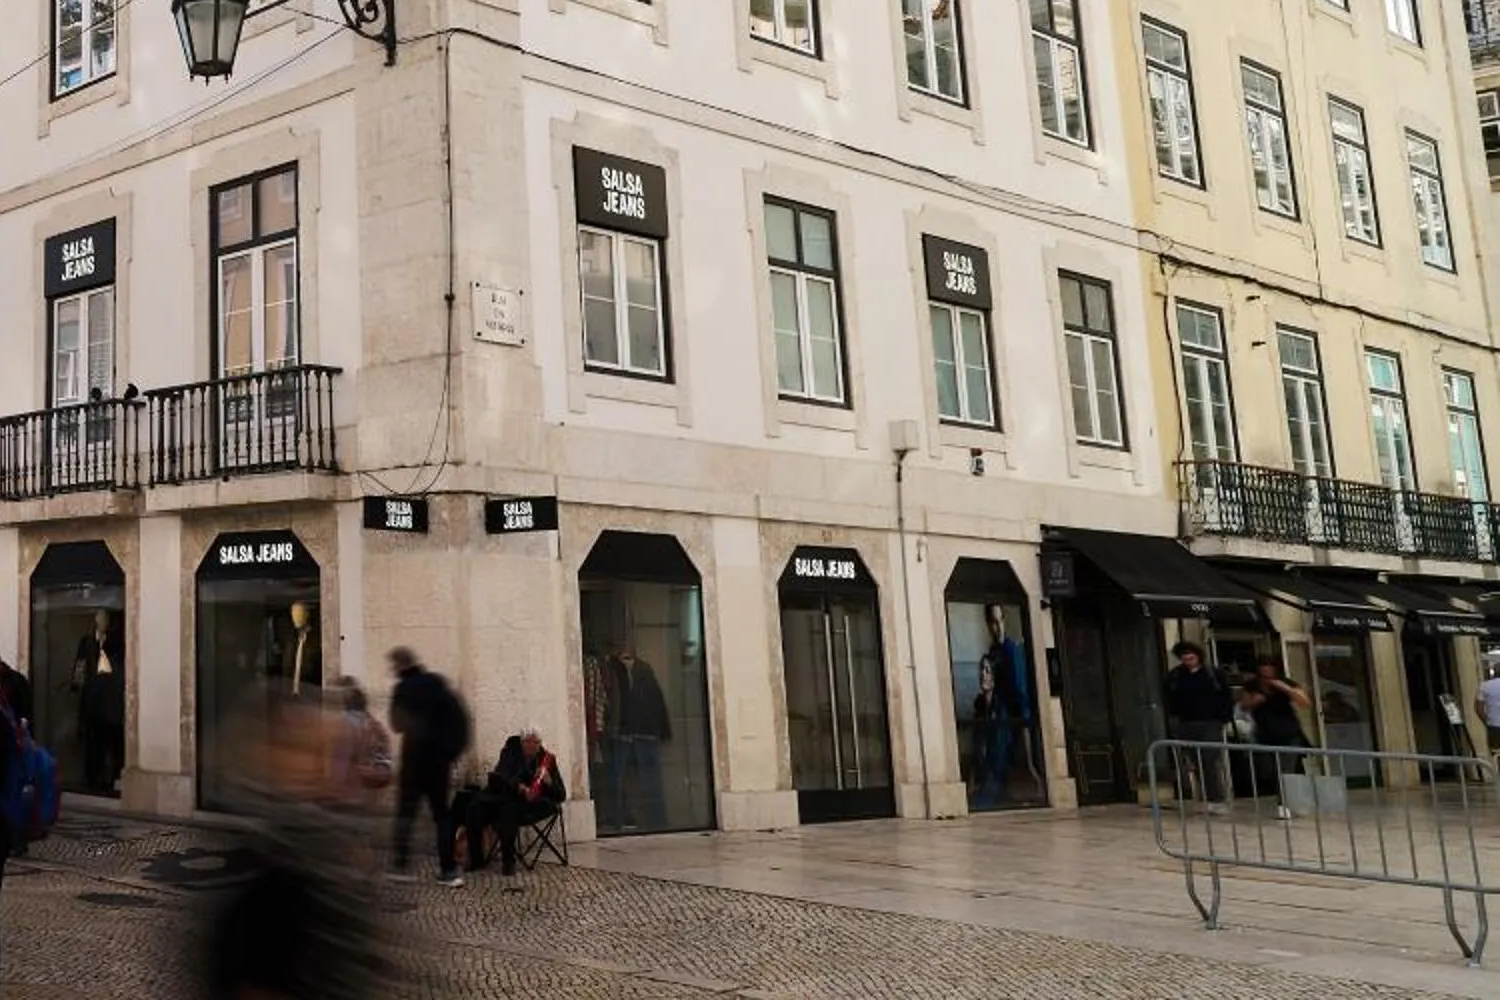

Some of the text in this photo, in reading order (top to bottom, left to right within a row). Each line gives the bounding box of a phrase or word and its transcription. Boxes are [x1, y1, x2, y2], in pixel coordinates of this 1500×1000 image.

[601, 167, 644, 197] SALSA
[603, 191, 645, 219] JEANS
[62, 236, 95, 262] SALSA
[61, 255, 95, 281] JEANS
[943, 251, 974, 276] SALSA
[945, 271, 977, 295] JEANS
[385, 501, 412, 516] SALSA
[503, 501, 532, 516] SALSA
[385, 514, 413, 529] JEANS
[503, 514, 534, 530] JEANS
[220, 542, 293, 564] SALSA JEANS
[795, 558, 855, 579] SALSA JEANS
